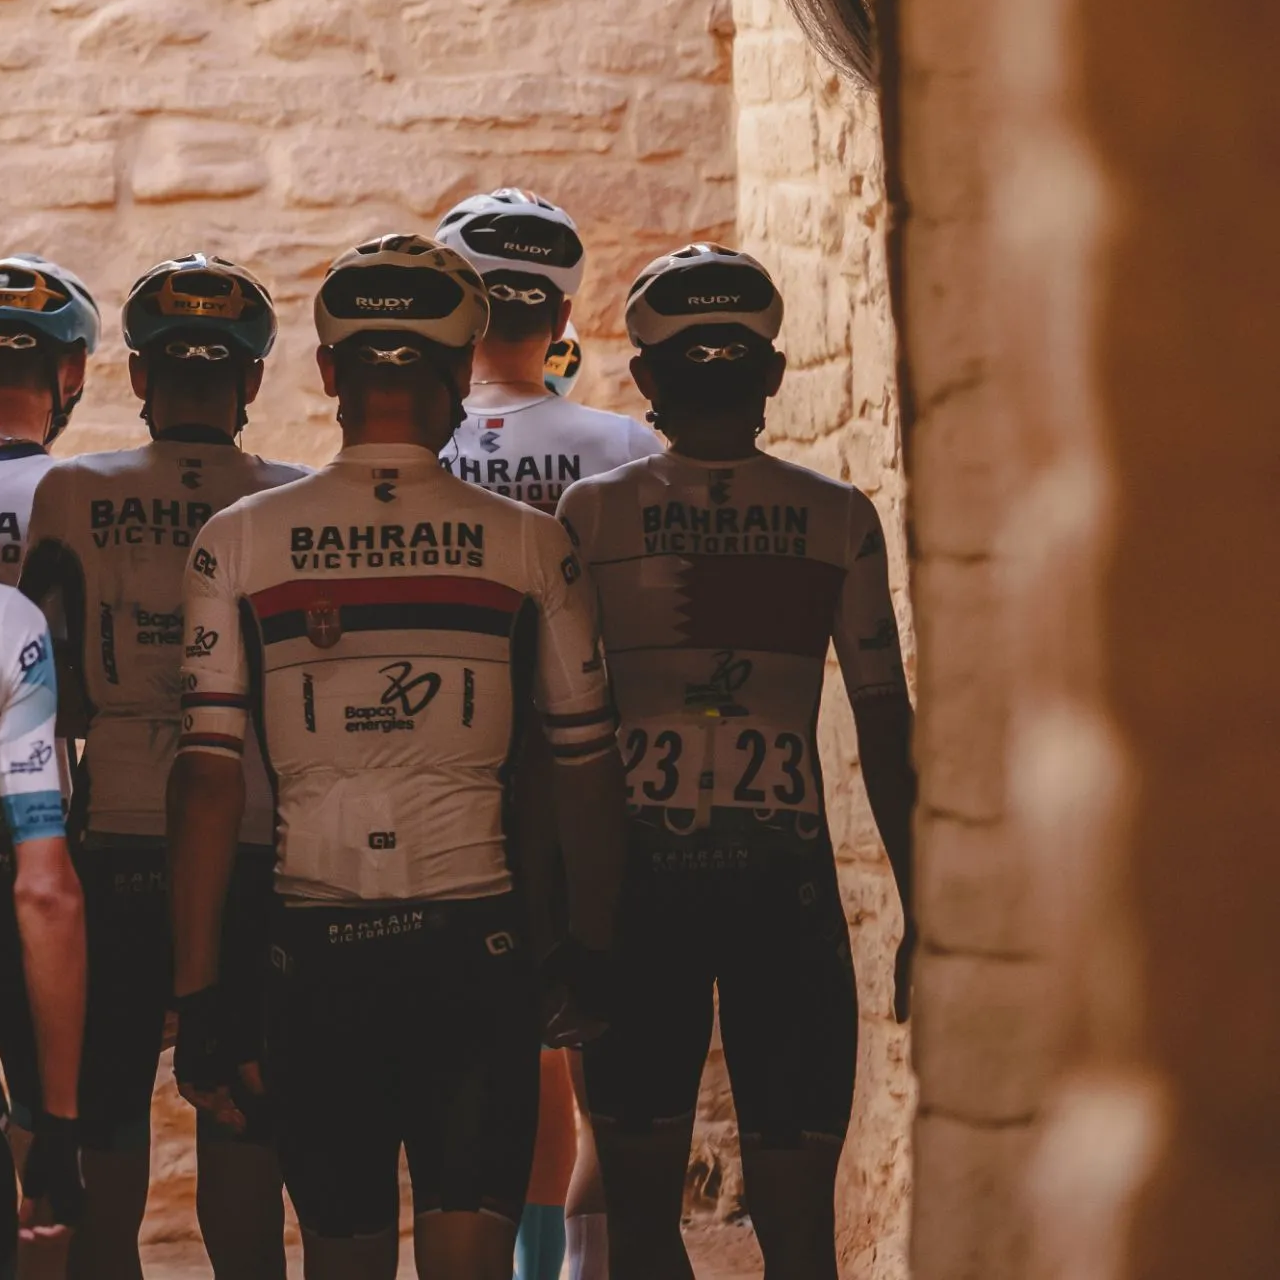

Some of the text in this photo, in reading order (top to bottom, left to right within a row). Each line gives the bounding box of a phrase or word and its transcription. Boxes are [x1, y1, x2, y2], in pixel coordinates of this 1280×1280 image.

[503, 241, 553, 256] RUDY
[174, 300, 226, 311] RUDY
[355, 296, 414, 307] RUDY
[687, 294, 740, 305] RUDY
[91, 497, 213, 529] BAHR
[643, 501, 808, 534] BAHRAIN
[92, 526, 191, 549] VICTO
[290, 522, 484, 552] BAHRAIN
[645, 532, 807, 555] VICTORIOUS
[290, 549, 484, 570] VICTORIOUS
[345, 706, 396, 720] Bapco
[345, 718, 414, 733] energies
[626, 728, 806, 805] 23 23
[329, 910, 424, 936] BAHRAIN
